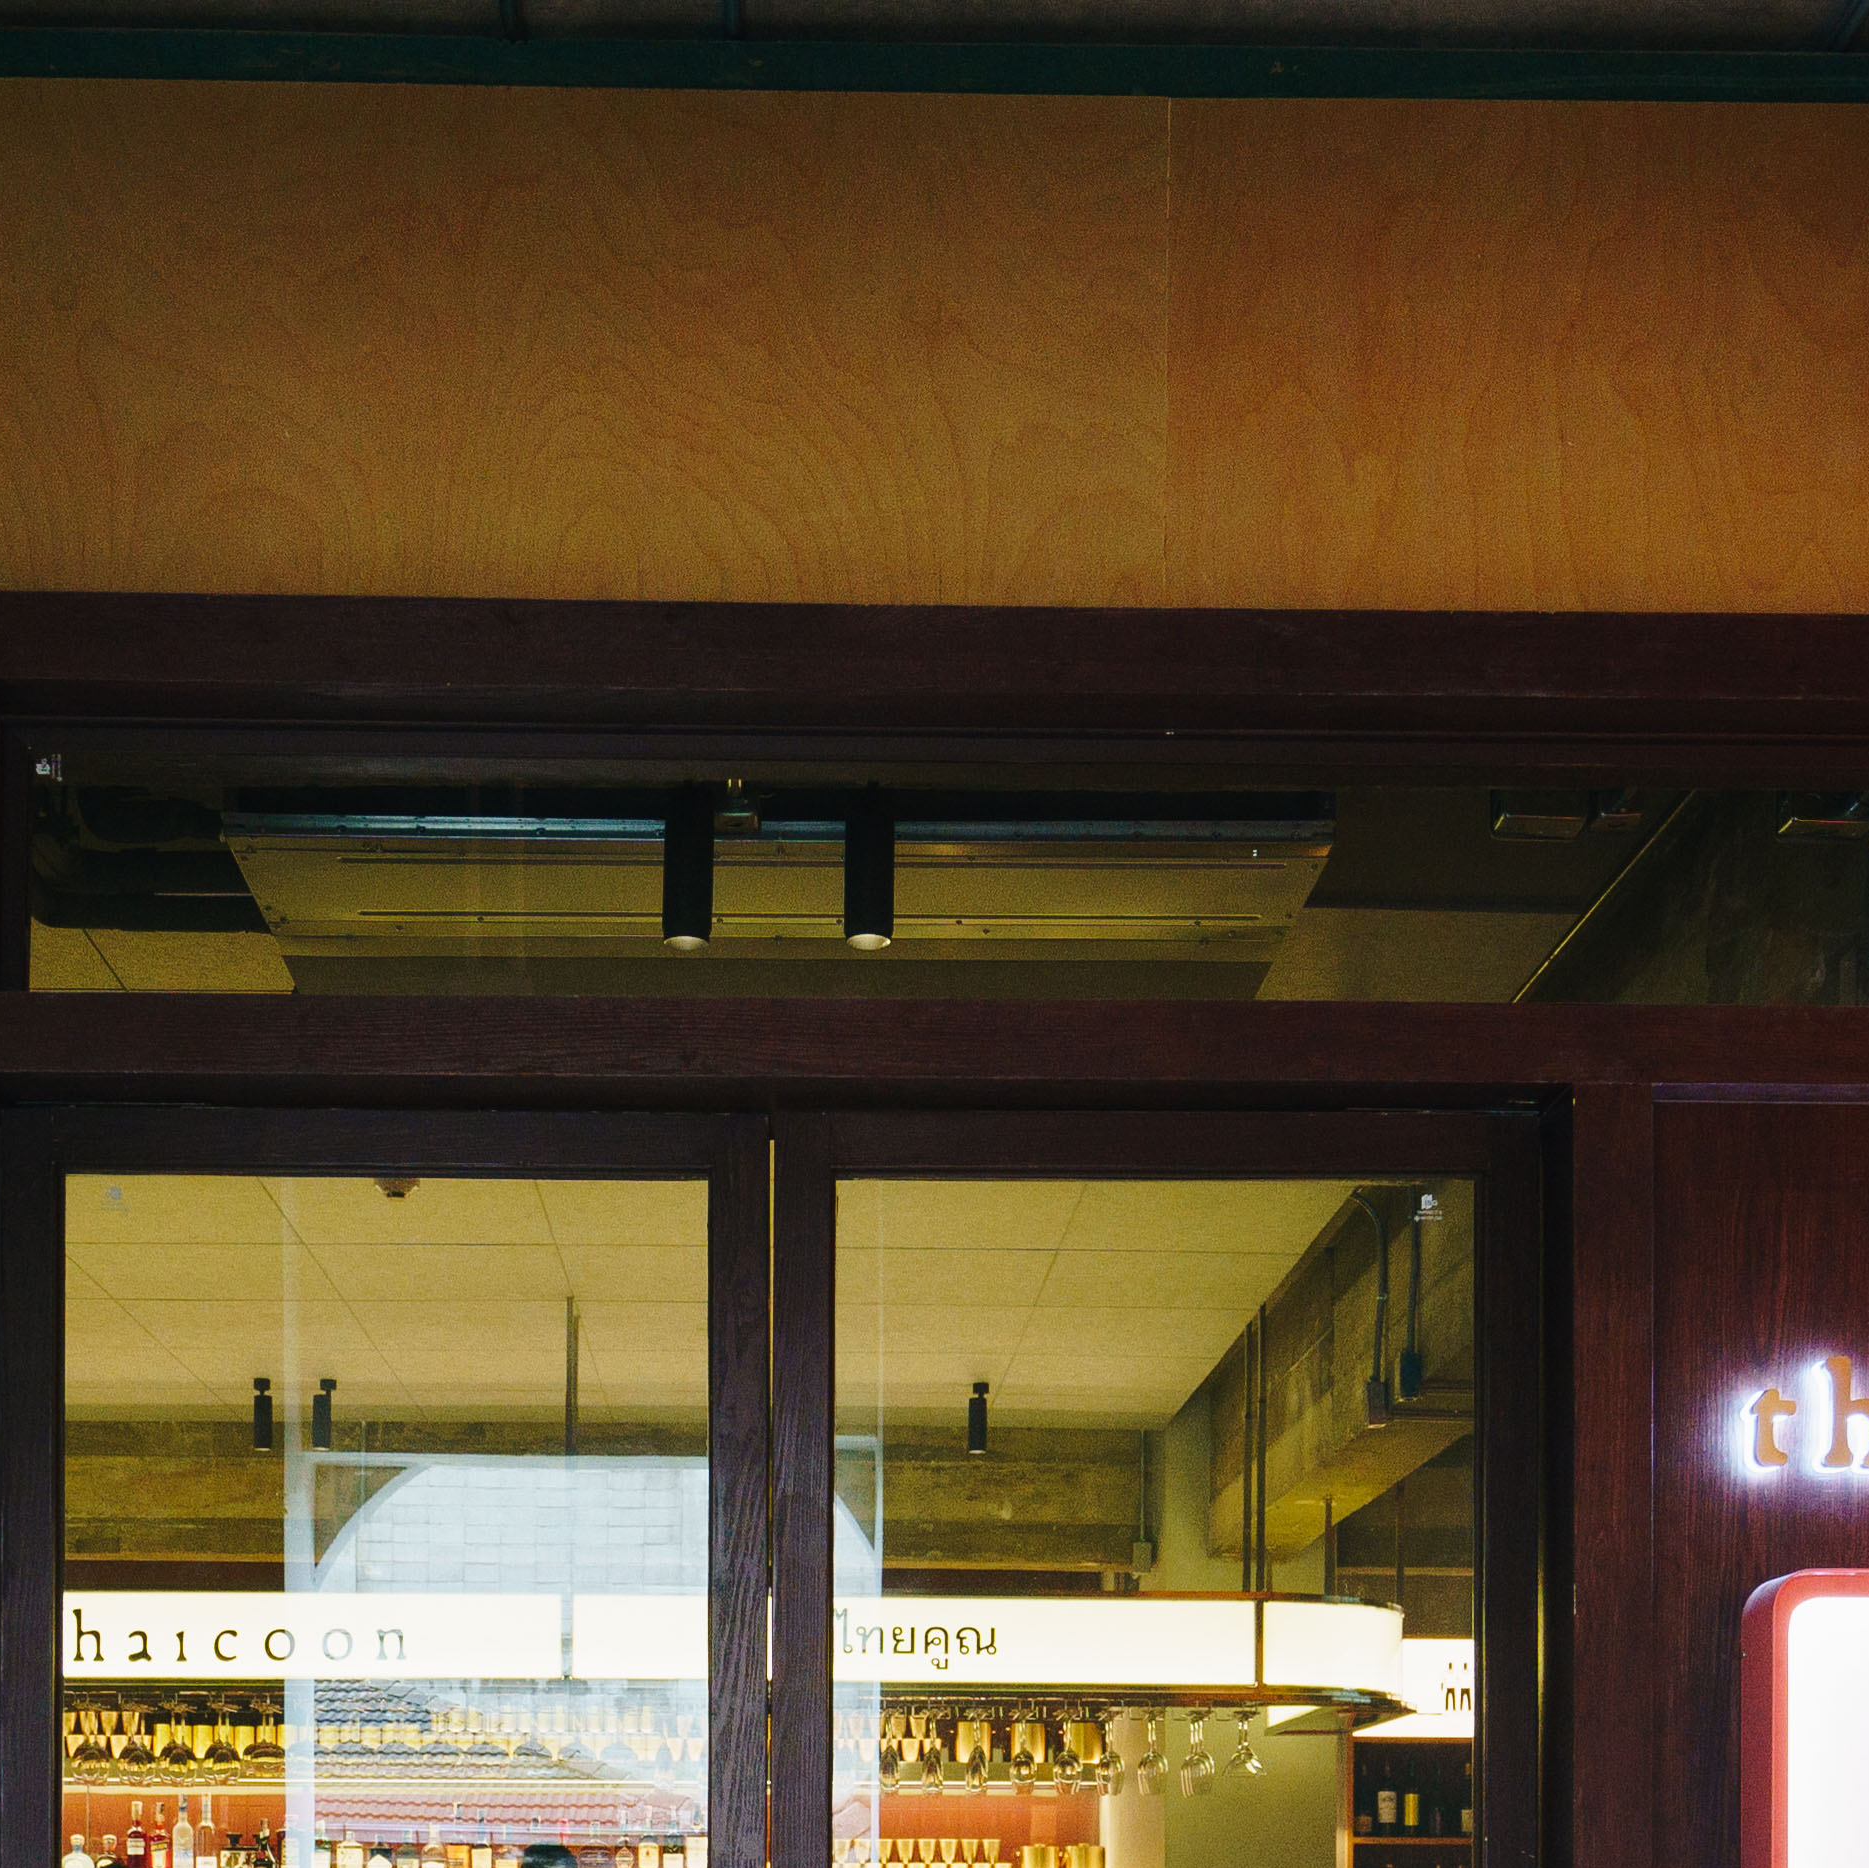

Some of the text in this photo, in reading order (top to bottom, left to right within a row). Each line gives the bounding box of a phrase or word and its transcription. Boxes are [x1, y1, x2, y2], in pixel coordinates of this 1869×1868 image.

[72, 1608, 407, 1662] haicoon
[834, 1608, 997, 1670] ไทยคูณ
